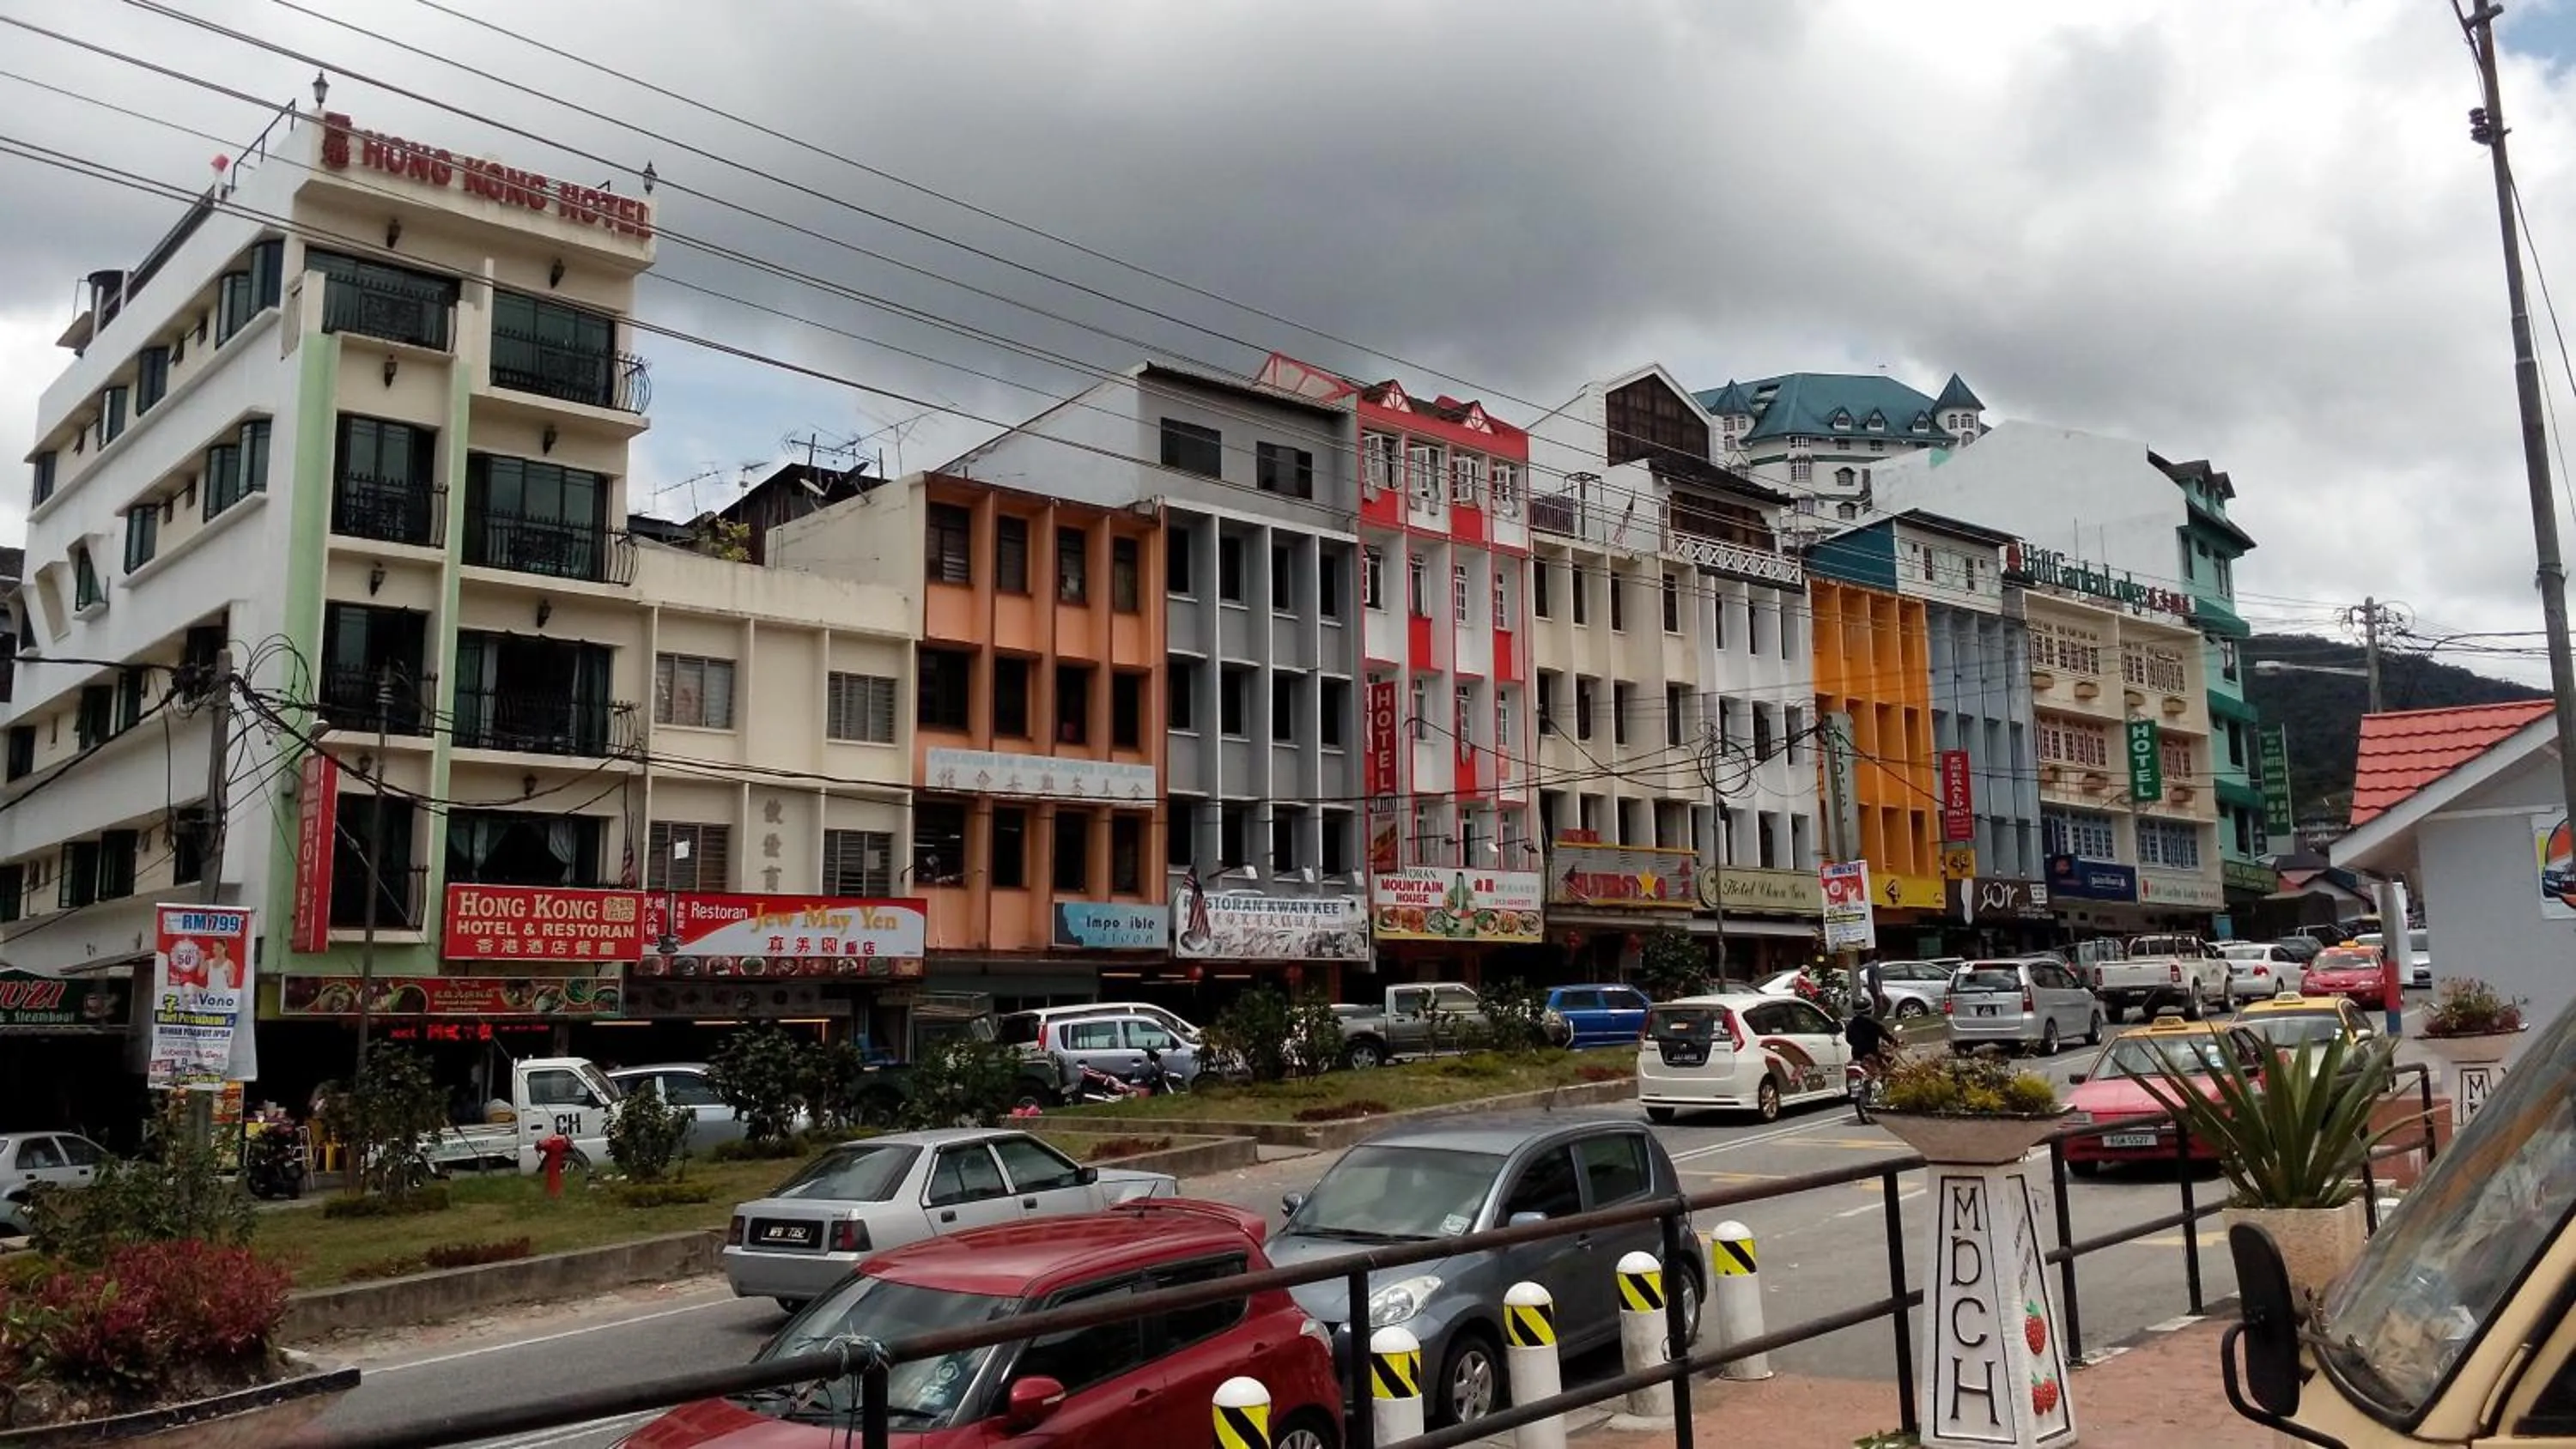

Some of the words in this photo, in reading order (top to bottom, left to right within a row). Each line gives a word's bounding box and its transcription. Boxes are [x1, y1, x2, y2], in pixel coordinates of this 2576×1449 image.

[363, 130, 453, 186] HONG
[463, 156, 549, 211] KONG
[558, 181, 652, 239] HOTEL
[1376, 689, 1392, 789] HOTEL
[2132, 725, 2152, 798] HOTEL
[1381, 878, 1443, 894] MOUNTAIN
[1396, 893, 1430, 904] HOUSE
[690, 901, 749, 920] Restoran
[750, 902, 798, 933] Jew
[802, 904, 853, 935] May
[860, 906, 897, 931] Yen
[1183, 894, 1261, 912] RSTORAN
[1267, 900, 1308, 913] KWAN
[1313, 902, 1340, 914] KEE
[457, 921, 517, 936] HOTEL
[523, 923, 536, 937] &
[542, 923, 635, 938] RESTORAN
[0, 979, 67, 1010] UZI
[556, 1113, 582, 1135] CH
[1950, 1185, 2001, 1427] MDCH
